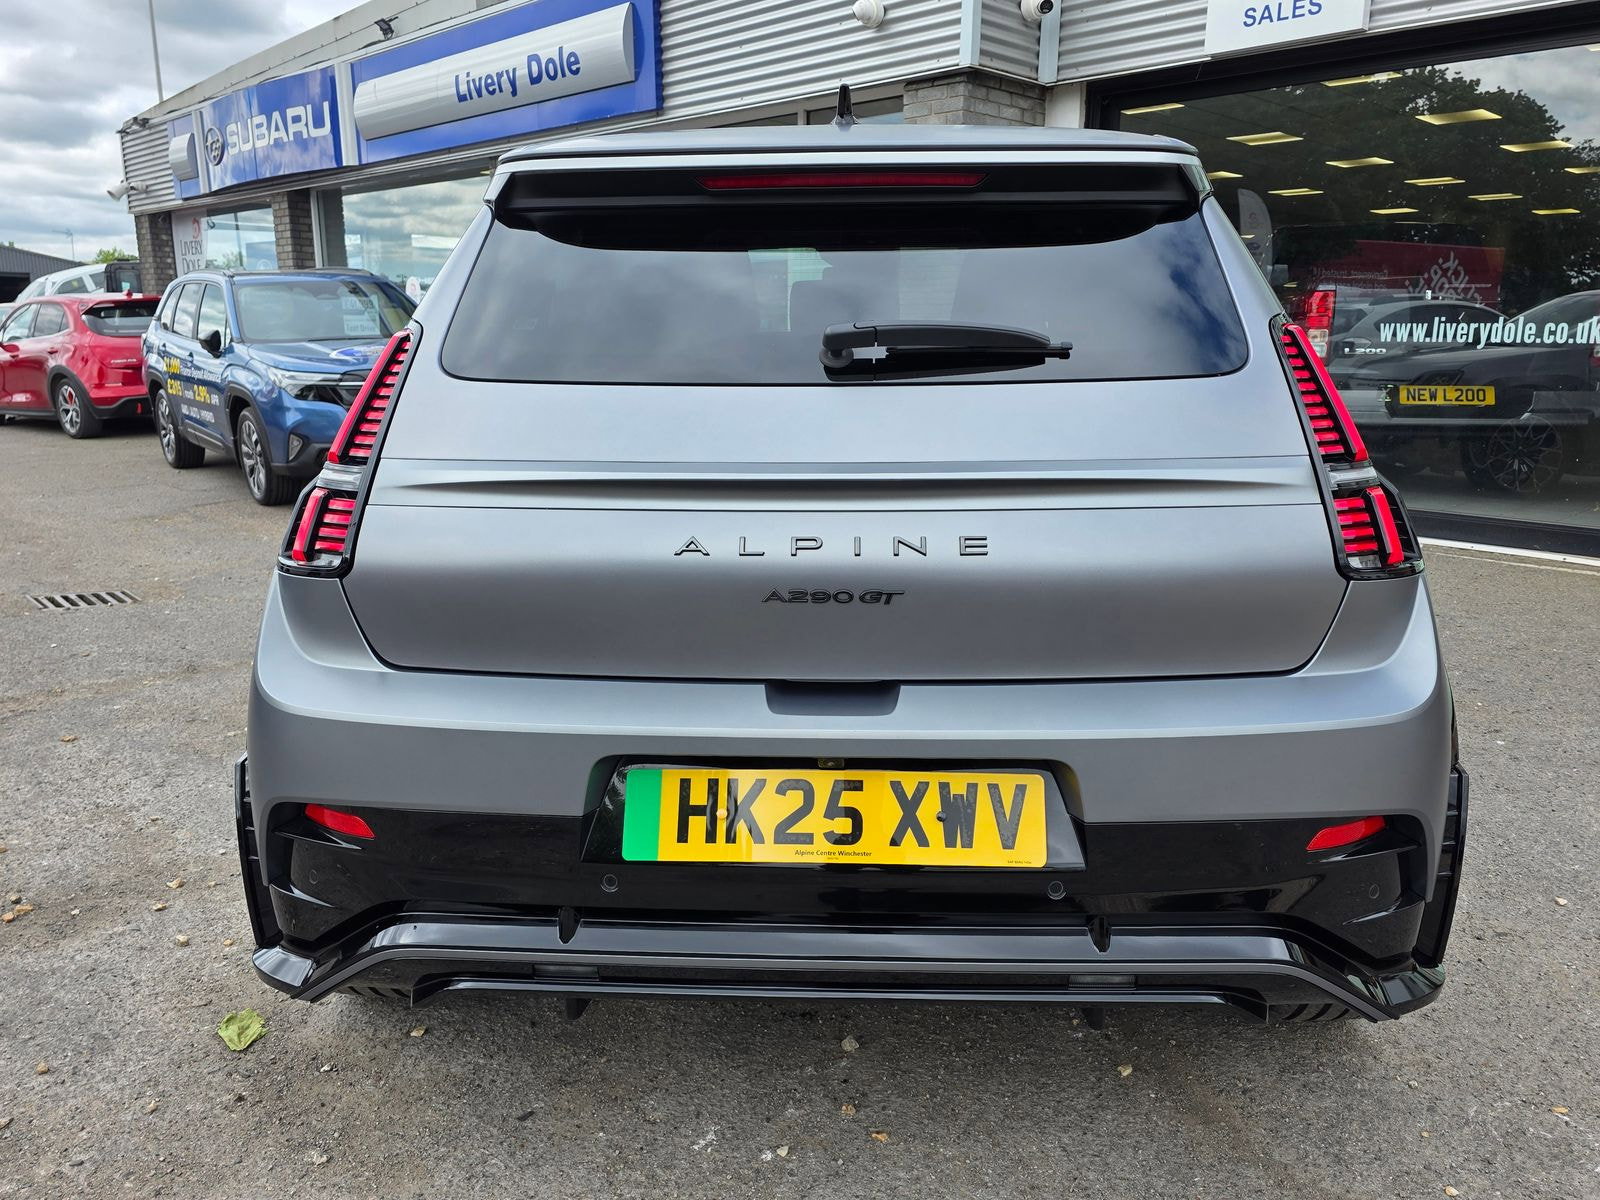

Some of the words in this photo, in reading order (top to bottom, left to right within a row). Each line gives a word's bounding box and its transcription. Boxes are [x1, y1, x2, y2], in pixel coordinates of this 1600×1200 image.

[1243, 0, 1322, 27] SALES
[455, 71, 518, 103] Livery
[527, 46, 581, 85] Dole
[226, 101, 331, 156] SUBARU
[180, 239, 203, 256] LIVERY
[1380, 316, 1600, 350] www.liverydole.co.uk
[1344, 347, 1387, 355] L200
[1406, 388, 1438, 402] NEW
[1443, 388, 1487, 402] L200
[673, 535, 989, 557] ALPINE
[676, 777, 864, 846] HK25
[889, 780, 1028, 850] XWV
[794, 849, 815, 857] Alpine
[816, 849, 837, 857] Centre
